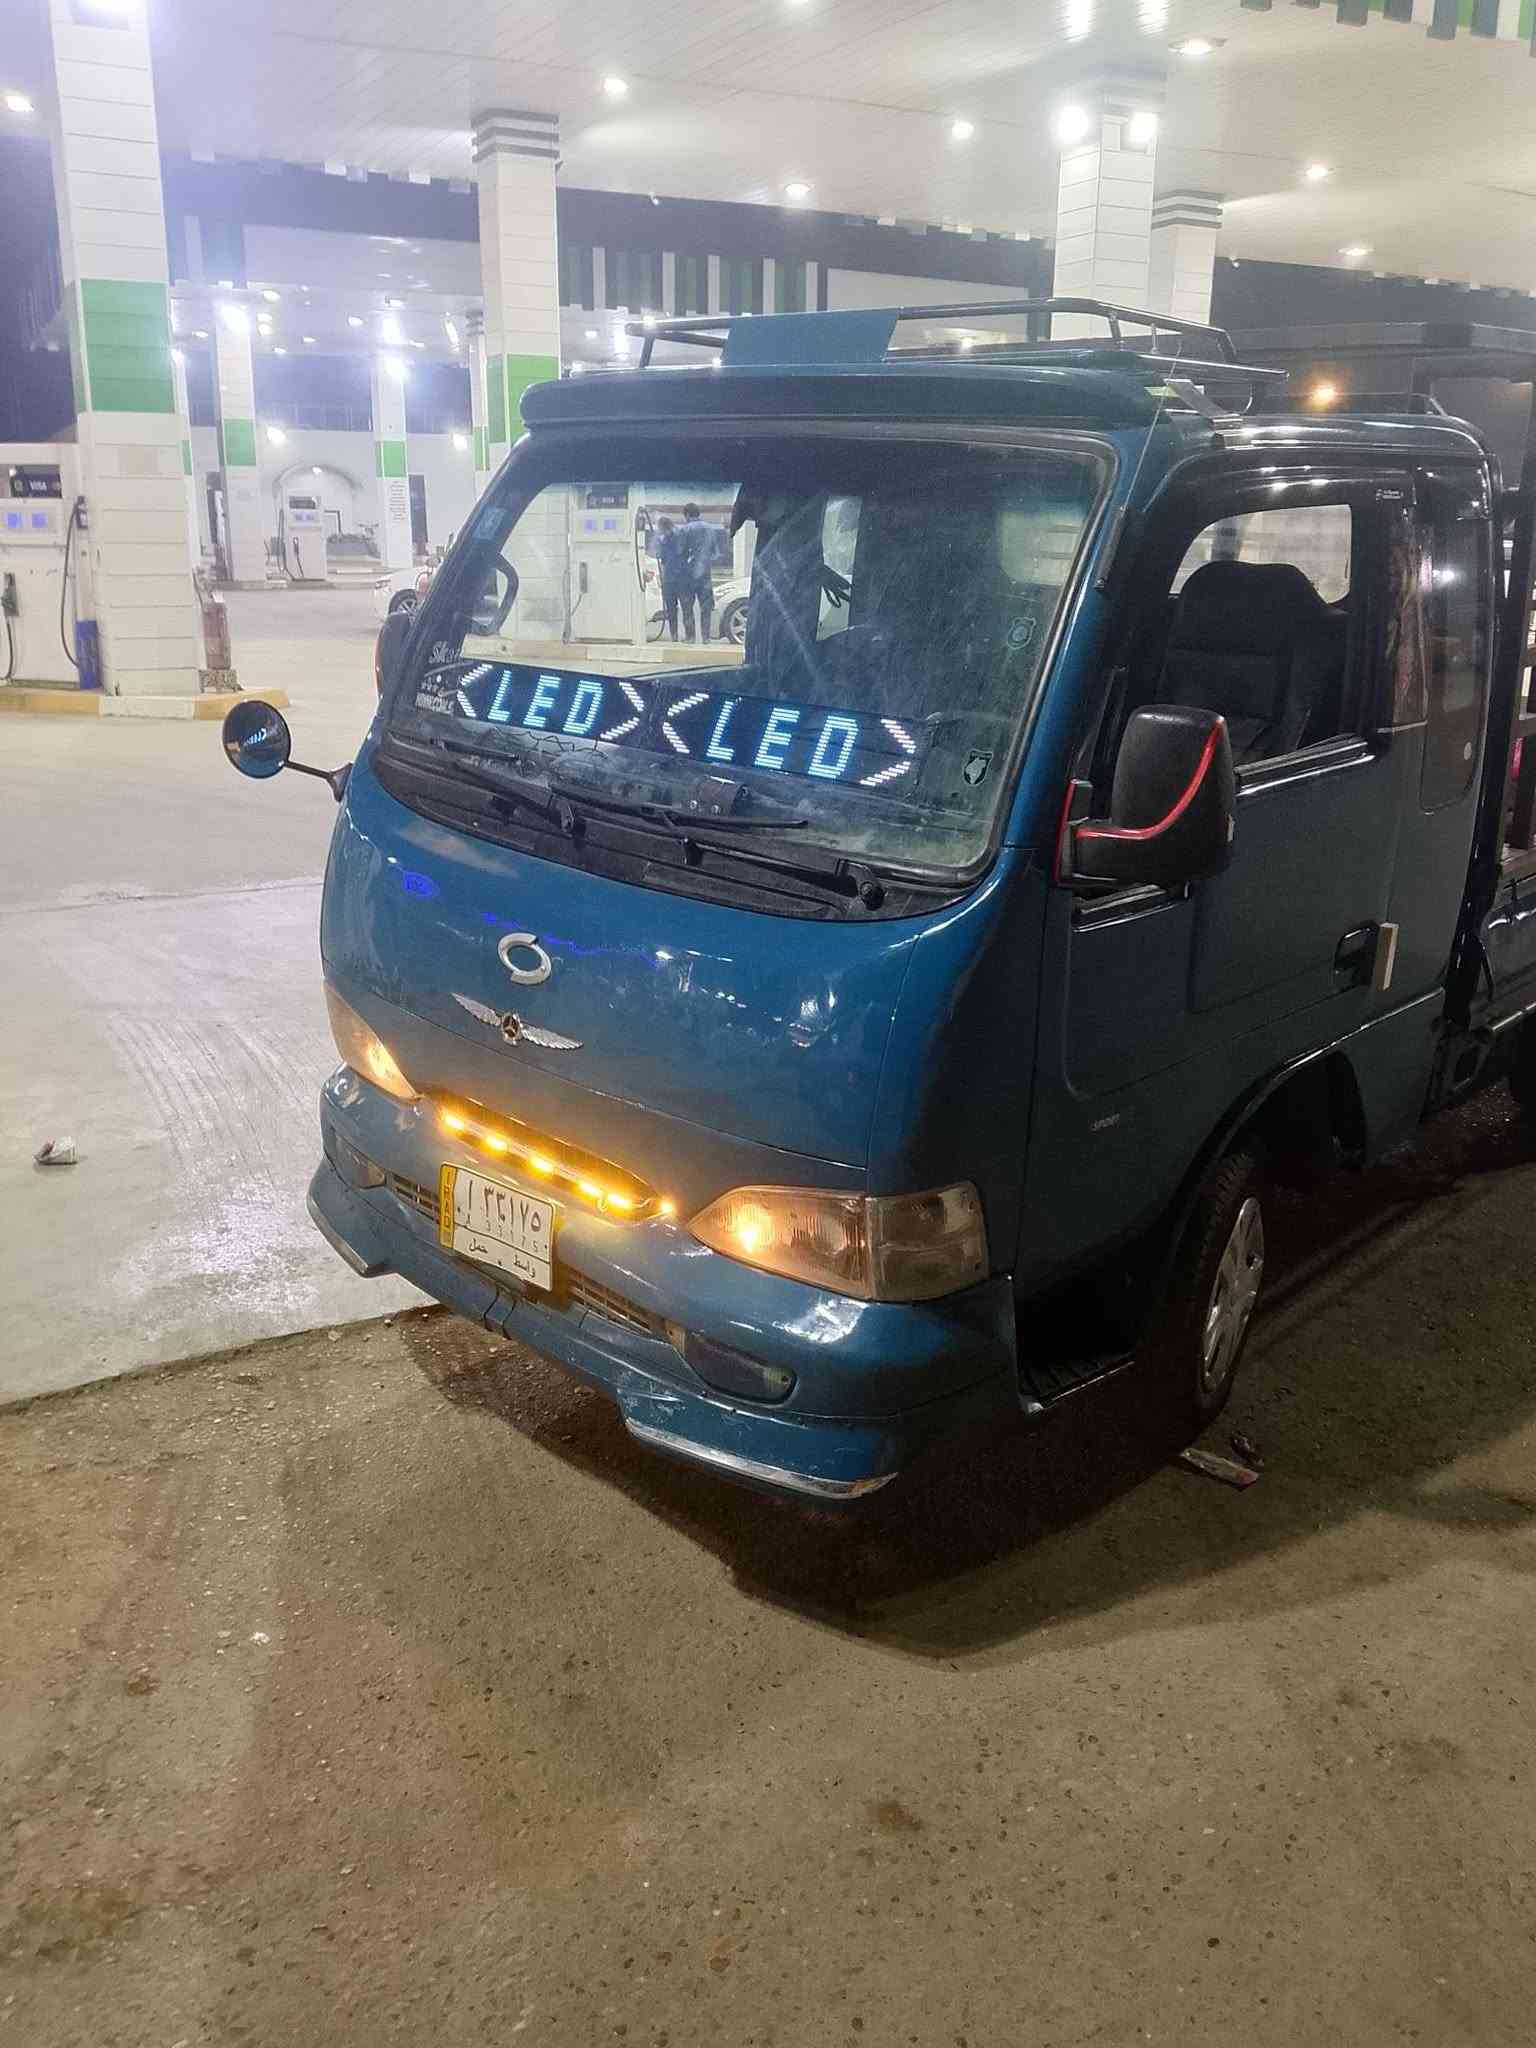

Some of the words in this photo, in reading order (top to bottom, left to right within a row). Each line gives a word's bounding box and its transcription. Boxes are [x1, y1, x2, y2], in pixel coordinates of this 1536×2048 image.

[487, 669, 604, 735] LED
[706, 699, 858, 779] LED
[468, 1237, 489, 1254] حمل
[512, 1254, 537, 1279] واسط
